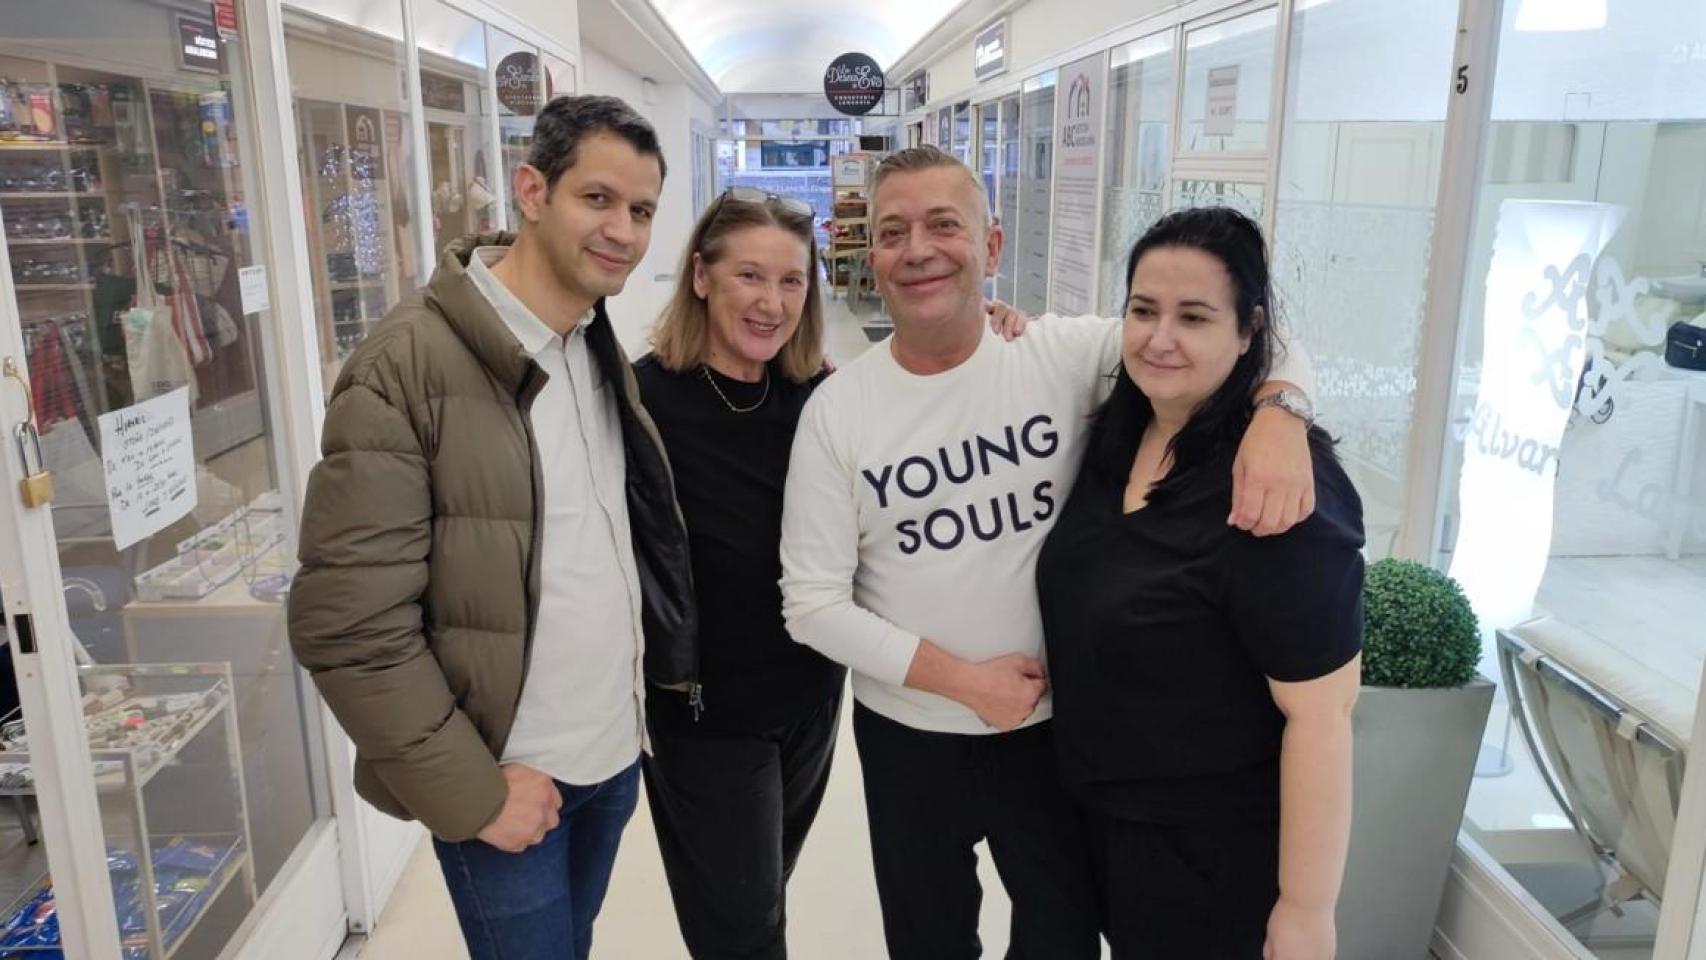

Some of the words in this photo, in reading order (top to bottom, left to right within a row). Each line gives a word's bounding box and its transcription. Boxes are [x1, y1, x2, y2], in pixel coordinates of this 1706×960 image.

[1456, 65, 1469, 94] 5
[862, 415, 1059, 508] YOUNG
[896, 480, 1055, 555] SOULS
